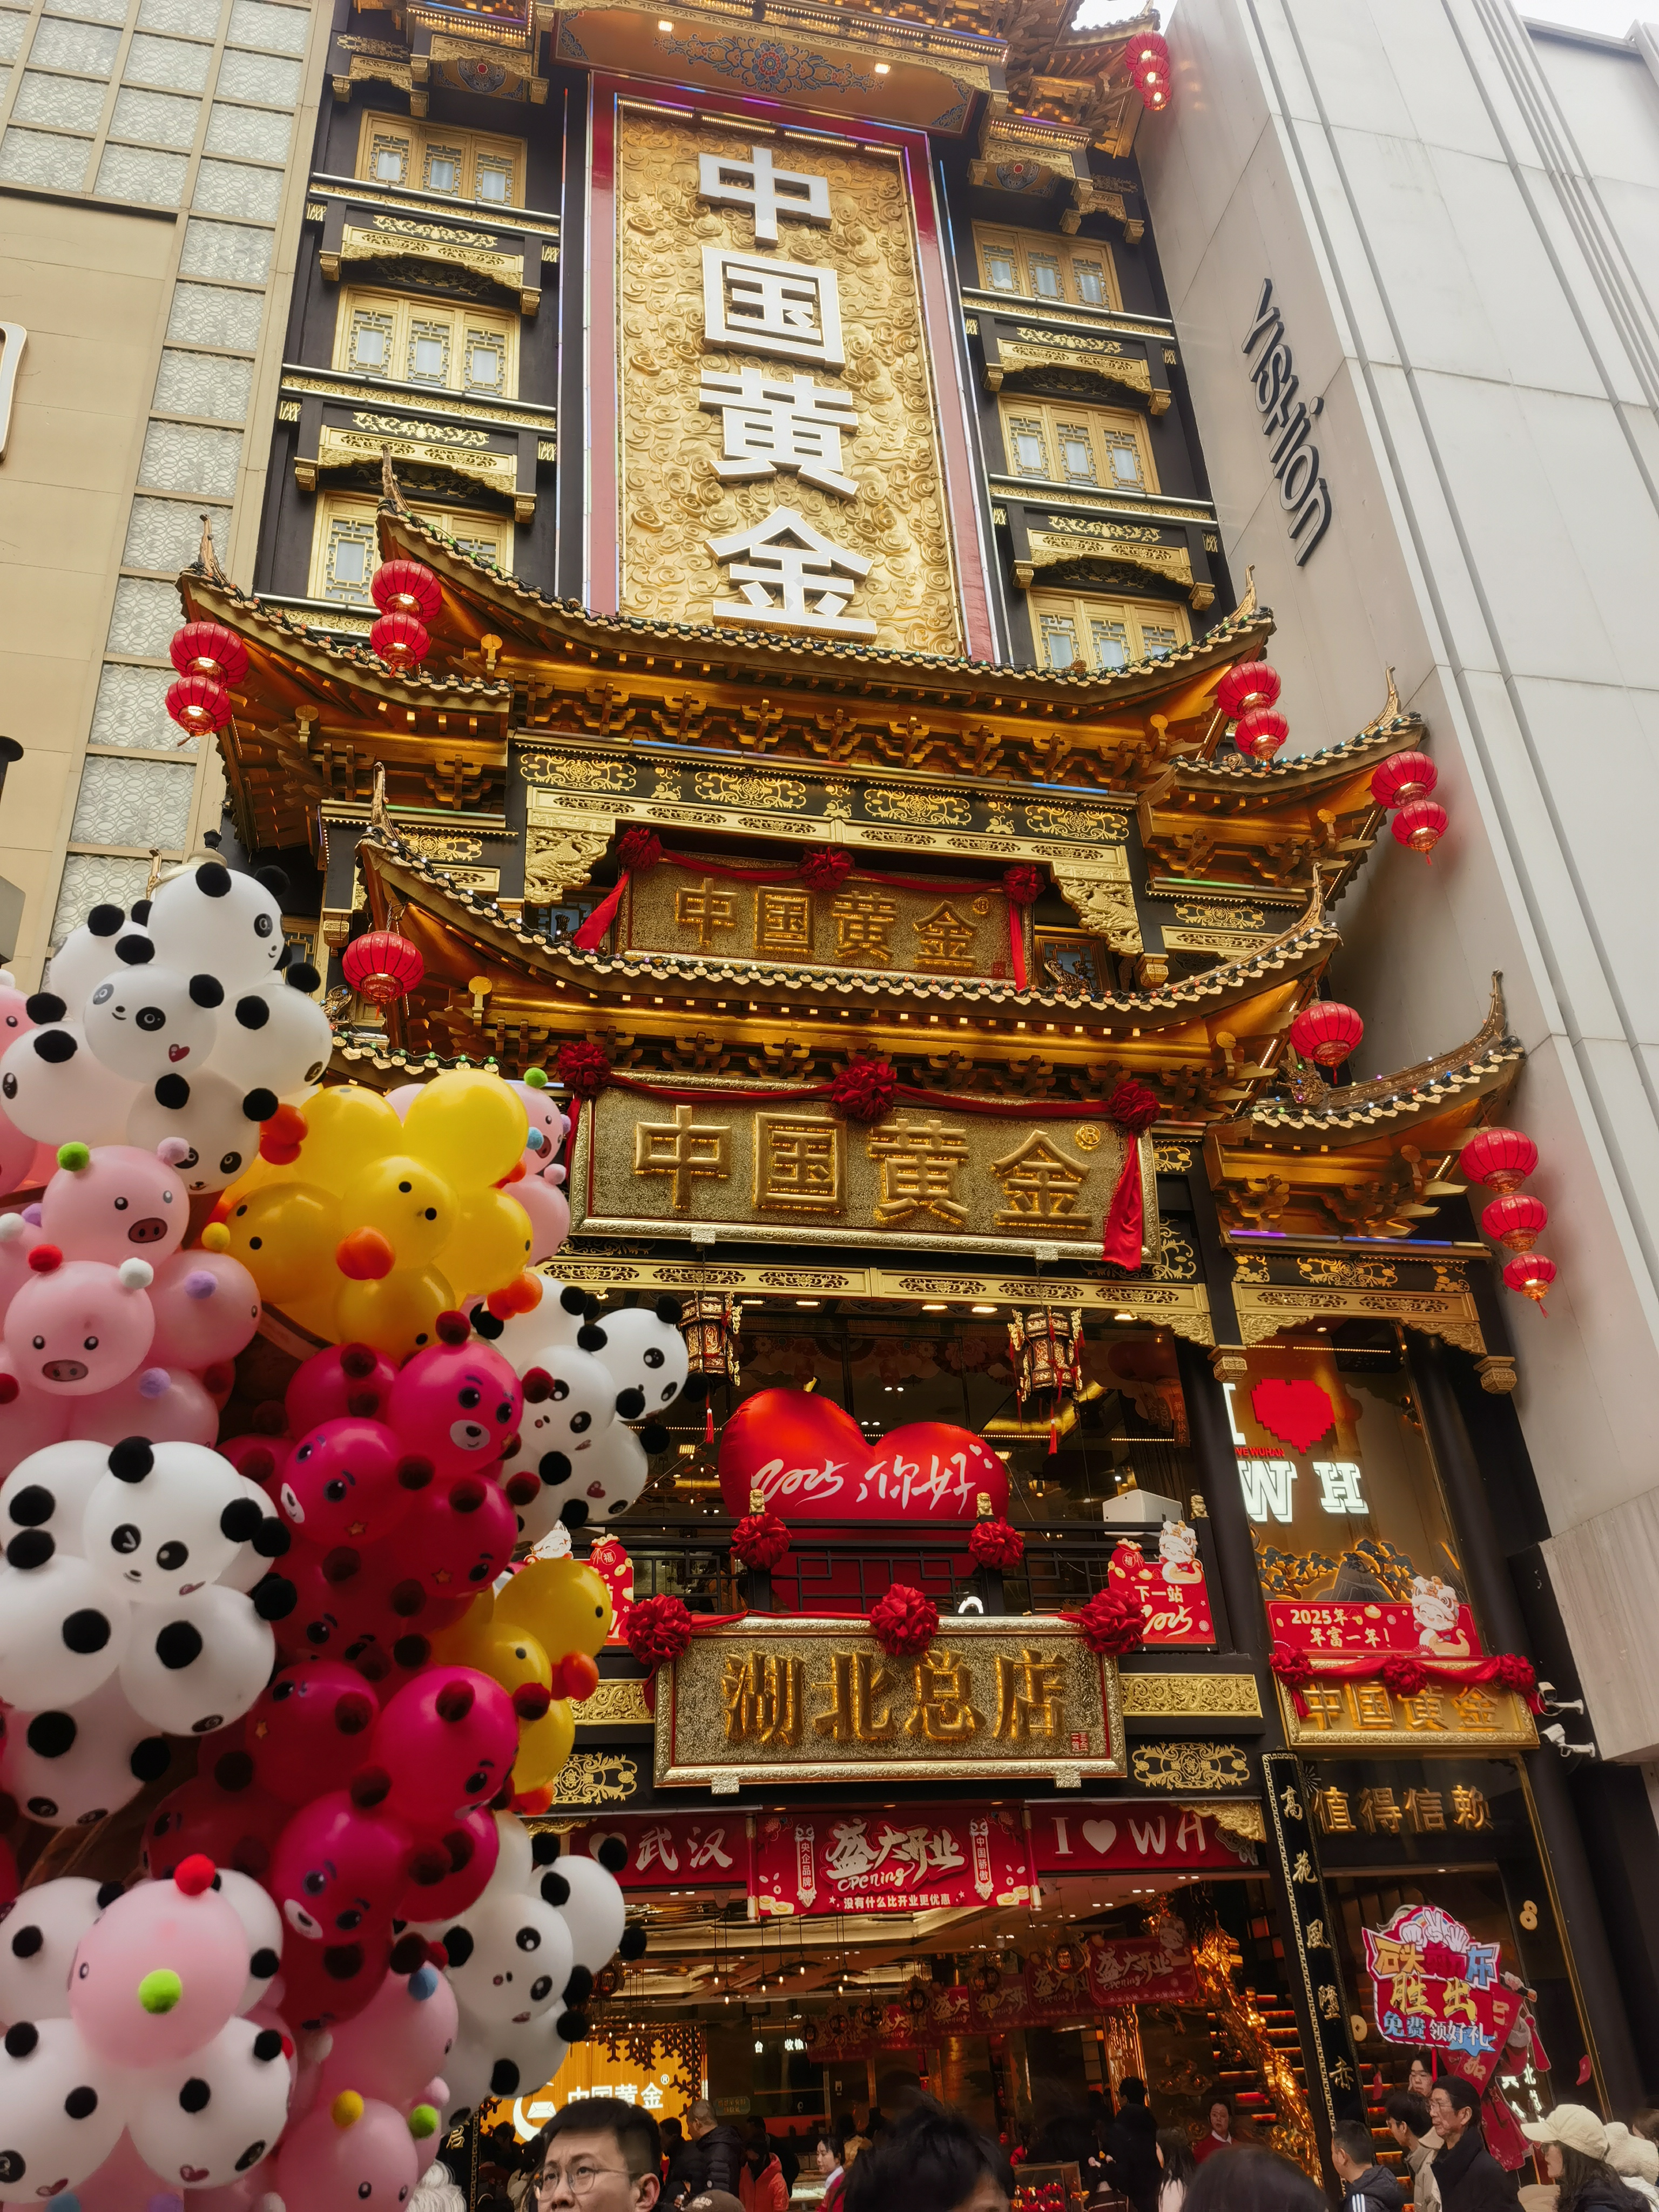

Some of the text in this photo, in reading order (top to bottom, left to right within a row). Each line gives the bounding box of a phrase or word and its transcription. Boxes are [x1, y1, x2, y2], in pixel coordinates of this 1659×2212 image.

[698, 145, 877, 640] 中国黄金
[676, 878, 976, 966] 中国黄金
[635, 1104, 1092, 1229] 中国黄金
[1158, 1404, 1169, 1427] 2025
[1174, 1401, 1187, 1444] 新春快乐
[1235, 1447, 1285, 1457] VE WUHAN
[604, 1552, 614, 1563] 福
[1124, 1555, 1134, 1567] 福
[1135, 1585, 1184, 1603] 下一站
[1291, 1607, 1348, 1626] 2025年
[723, 1648, 1069, 1745] 湖北总店
[1301, 1681, 1504, 1730] 中国黄金
[1313, 1785, 1494, 1834] 值得信赖
[636, 1826, 733, 1871] 武汉
[825, 1818, 965, 1884] 盛大开业
[1051, 1817, 1074, 1854] I
[801, 1842, 812, 1887] 央企品牌
[976, 1837, 989, 1881] 中国骄傲
[844, 1892, 951, 1909] 没有什么比开业更优惠
[1095, 1948, 1174, 1984] 盛大开业
[1390, 1972, 1477, 2021] 胜出
[1382, 2011, 1489, 2047] 免费领好礼
